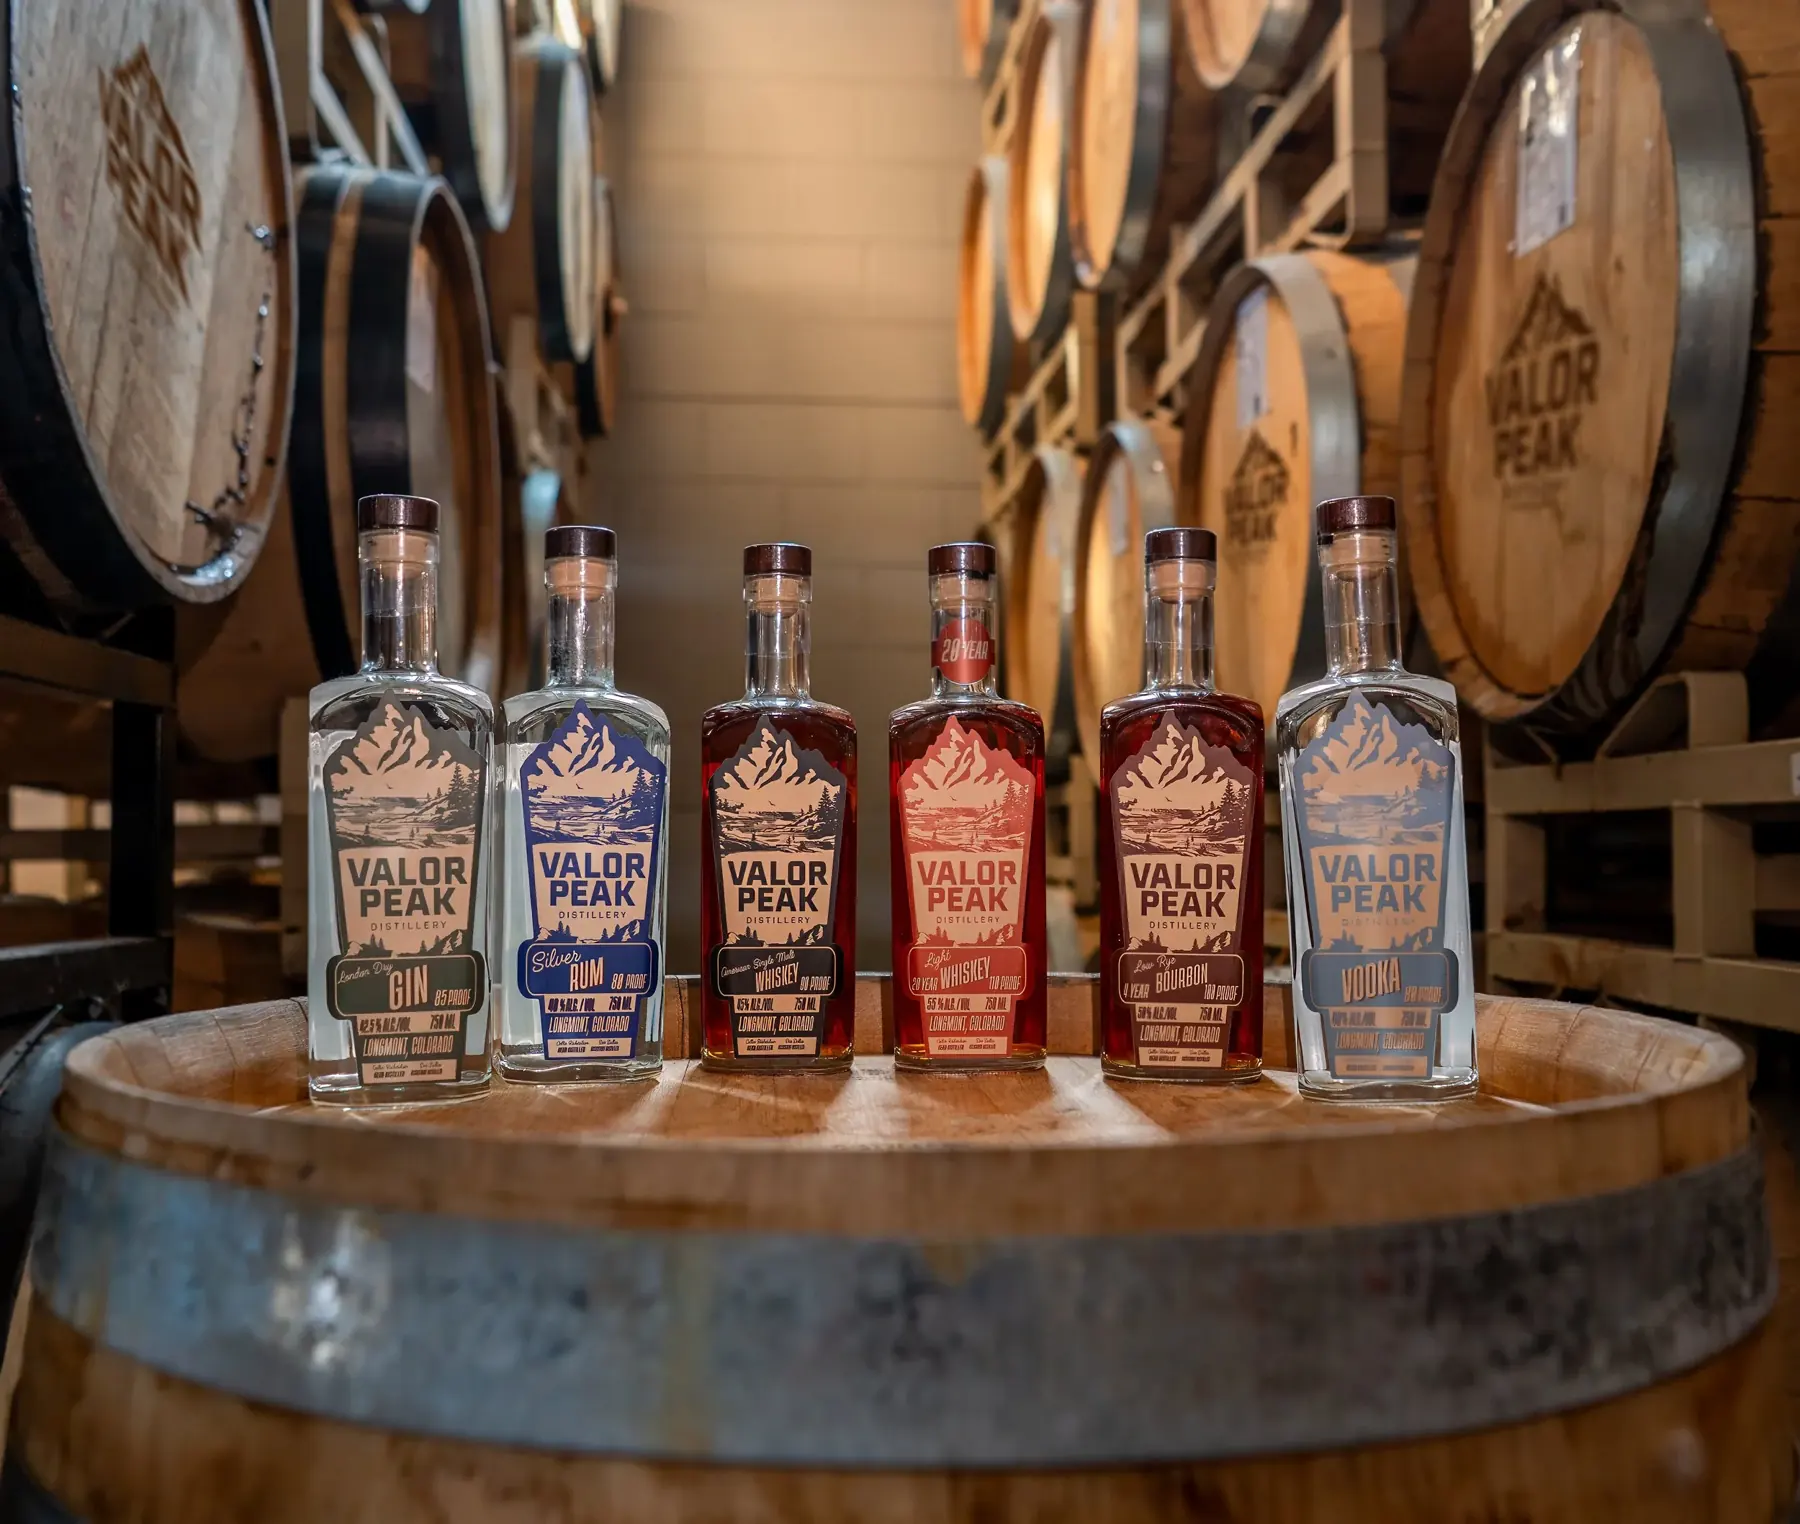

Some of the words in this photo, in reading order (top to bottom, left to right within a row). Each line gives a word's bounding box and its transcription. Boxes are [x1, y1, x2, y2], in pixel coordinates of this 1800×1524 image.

[1485, 340, 1599, 427] VALOR
[1494, 411, 1582, 480] PEAK
[942, 638, 961, 663] 20
[963, 640, 989, 660] YEAR
[347, 856, 467, 887] VALOR
[539, 852, 646, 879] VALOR
[727, 861, 828, 886] VALOR
[917, 860, 1017, 886] VALOR
[1130, 863, 1236, 889] VALOR
[1319, 854, 1437, 883] VALOR
[360, 887, 456, 917] PEAK
[550, 880, 635, 907] PEAK
[738, 887, 818, 912] PEAK
[928, 887, 1008, 912] PEAK
[1141, 891, 1226, 918] PEAK
[1331, 884, 1426, 913] PEAK
[370, 921, 447, 931] DISTILLERY
[558, 911, 627, 919] DISTILLERY
[746, 916, 810, 924] DISTILLERY
[936, 916, 1000, 924] DISTILLERY
[1150, 921, 1217, 930] DISTILLERY
[532, 948, 581, 973] Silver
[721, 964, 751, 978] American
[753, 955, 774, 971] Single
[776, 949, 796, 963] Malt
[924, 949, 952, 970] Light
[1134, 959, 1154, 974] Low
[1156, 954, 1176, 971] Rye
[337, 966, 370, 985] London
[372, 961, 394, 976] Dry
[569, 956, 604, 992] RUM
[611, 973, 624, 990] 80
[625, 973, 647, 989] PROOF
[755, 962, 799, 993] WHISKEY
[810, 976, 831, 991] PROOF
[912, 977, 921, 991] 20
[921, 977, 938, 991] YEAR
[940, 956, 990, 990] WHISKEY
[989, 976, 1000, 990] 110
[1000, 976, 1021, 990] PROOF
[1156, 962, 1208, 994] BOURBON
[1342, 956, 1401, 1003] VODKA
[389, 964, 428, 1011] GIN
[434, 989, 448, 1006] 85
[448, 988, 472, 1005] PROOF
[1123, 983, 1128, 998] 4
[1129, 983, 1150, 999] YEAR
[1204, 984, 1215, 1000] 100
[1215, 984, 1239, 1001] PROOF
[609, 996, 622, 1011] 750
[794, 997, 807, 1011] 750
[807, 997, 816, 1011] ML
[985, 997, 997, 1010] 750
[1200, 1007, 1212, 1021] 750
[1212, 1007, 1223, 1021] ML
[430, 1014, 444, 1029] 750
[444, 1013, 456, 1029] ML
[548, 1016, 590, 1037] LONGMONT,
[592, 1016, 630, 1033] COLORADO
[738, 1016, 777, 1035] LONGMONT,
[779, 1015, 815, 1031] COLORADO
[929, 1016, 967, 1035] LONGMONT,
[969, 1015, 1005, 1031] COLORADO
[363, 1036, 408, 1059] LONGMONT,
[412, 1035, 454, 1055] COLORADO
[1140, 1025, 1180, 1046] LONGMONT,
[1182, 1026, 1220, 1043] COLORADO
[1383, 1032, 1424, 1050] COLORADO
